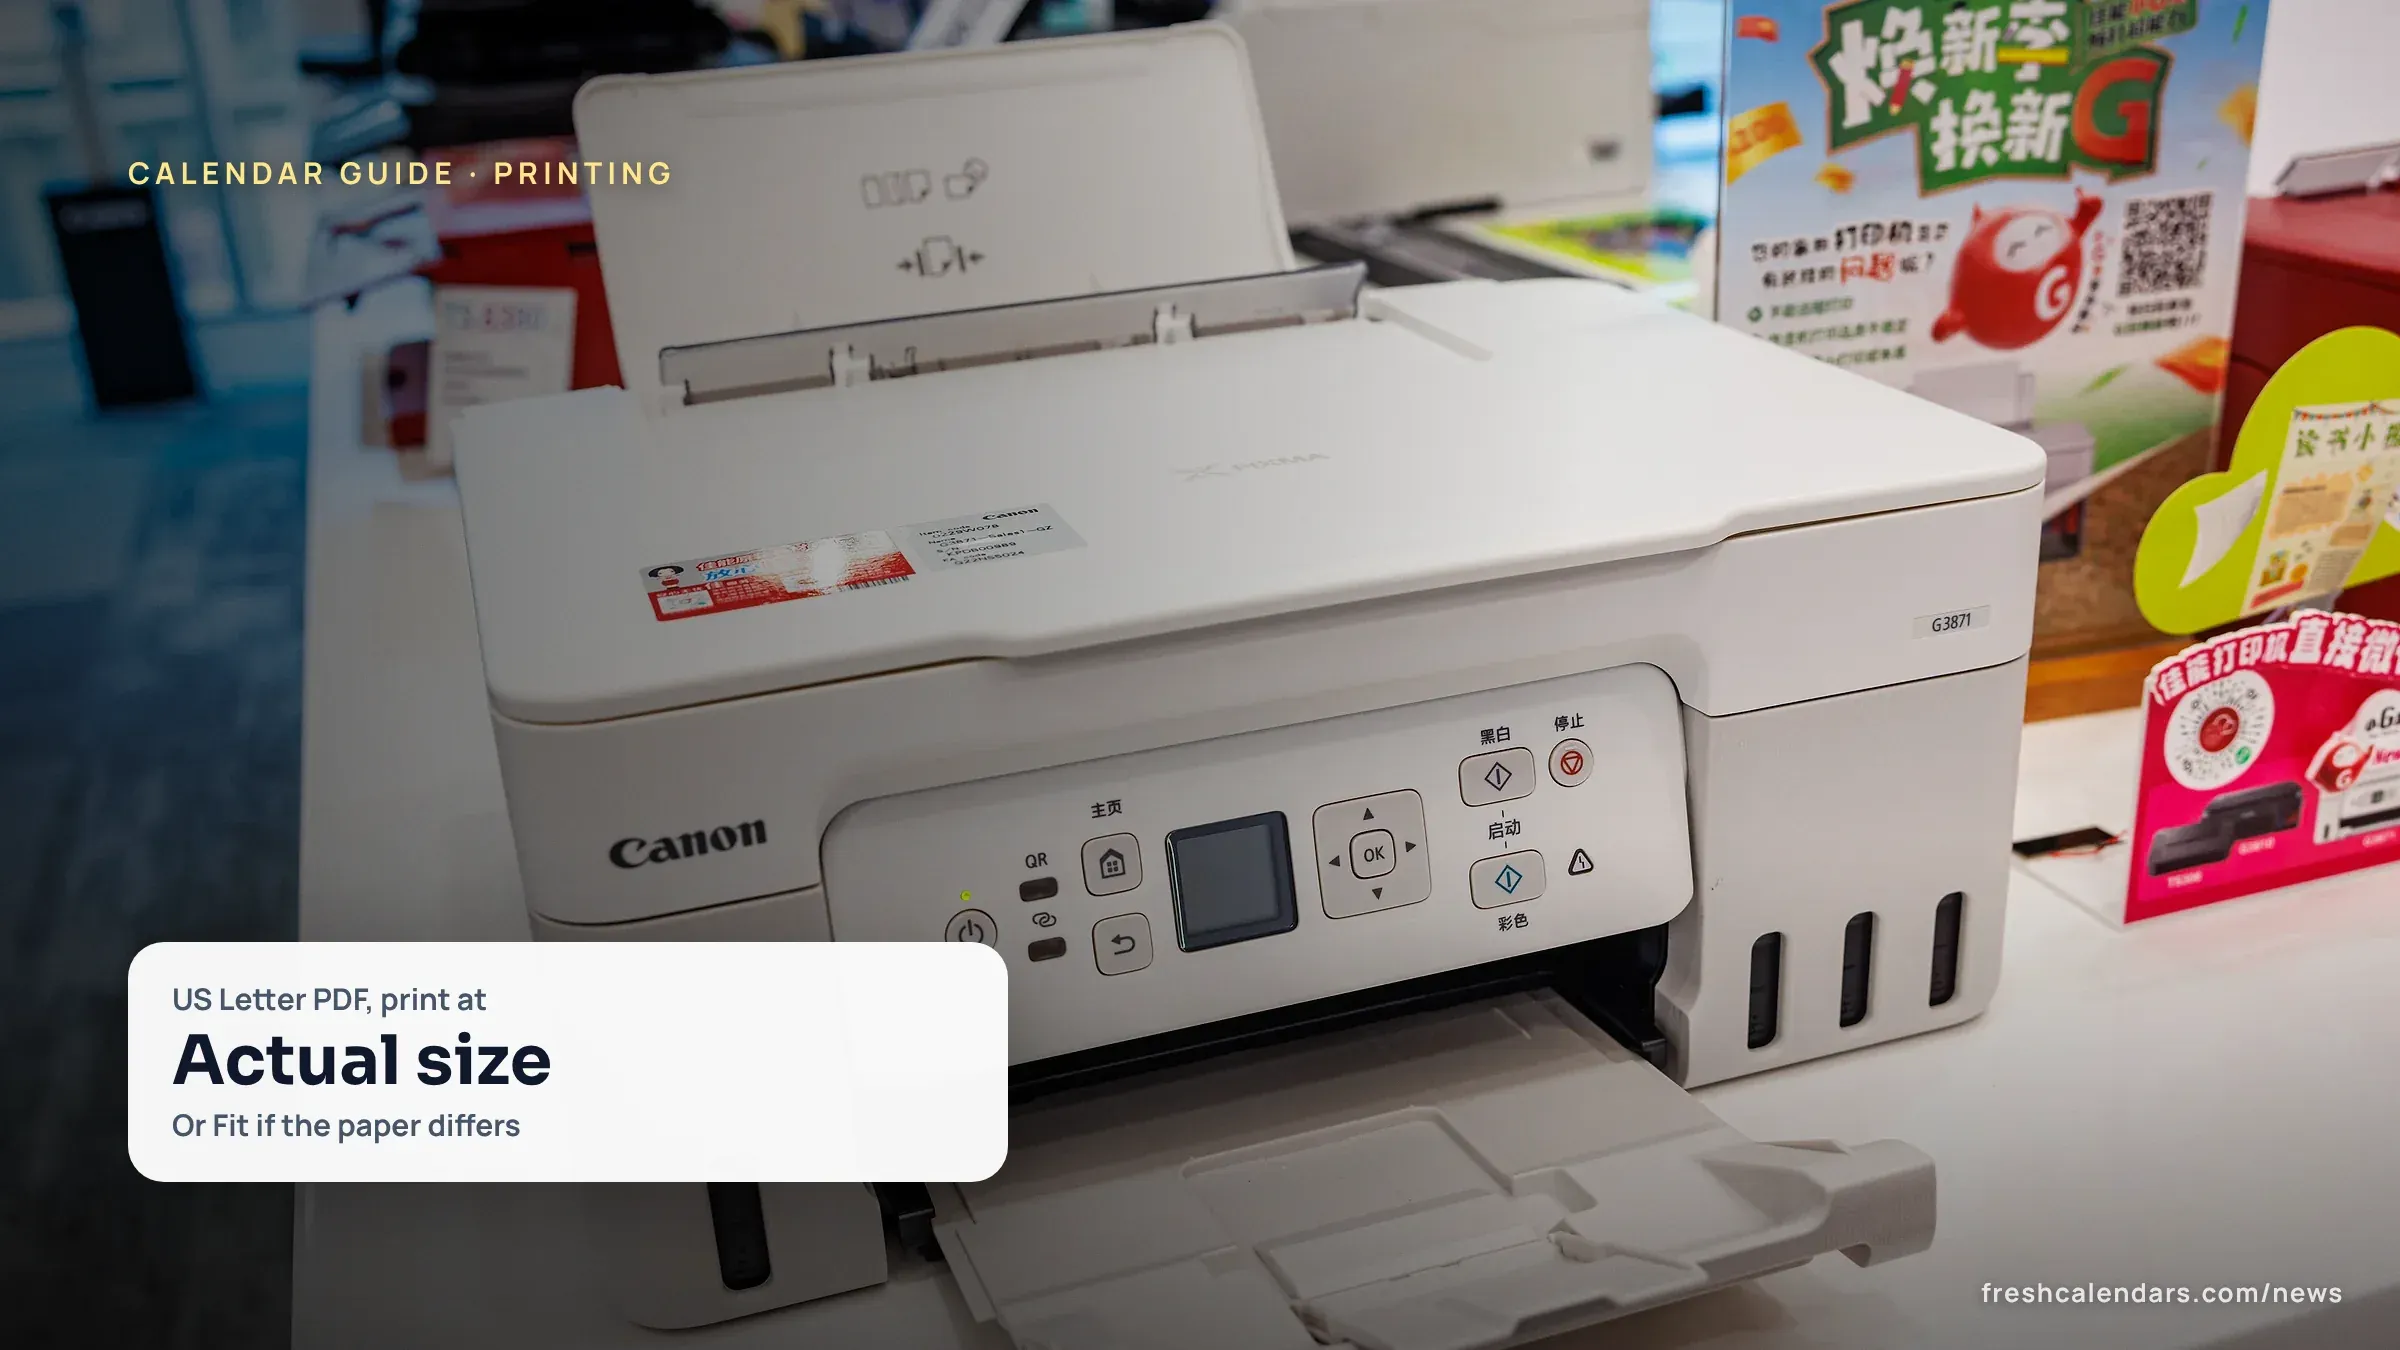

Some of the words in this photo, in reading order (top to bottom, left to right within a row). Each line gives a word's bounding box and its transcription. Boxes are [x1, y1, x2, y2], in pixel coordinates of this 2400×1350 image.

[982, 508, 1039, 520] Canon
[1931, 612, 1971, 632] G3871
[1554, 712, 1585, 732] 停止
[1480, 725, 1512, 746] 黑白
[1090, 799, 1123, 819] 主页
[1488, 818, 1522, 840] 启动
[608, 818, 768, 869] Canon
[1025, 852, 1049, 869] QR
[1363, 845, 1385, 863] OK
[1498, 913, 1529, 932] 彩色
